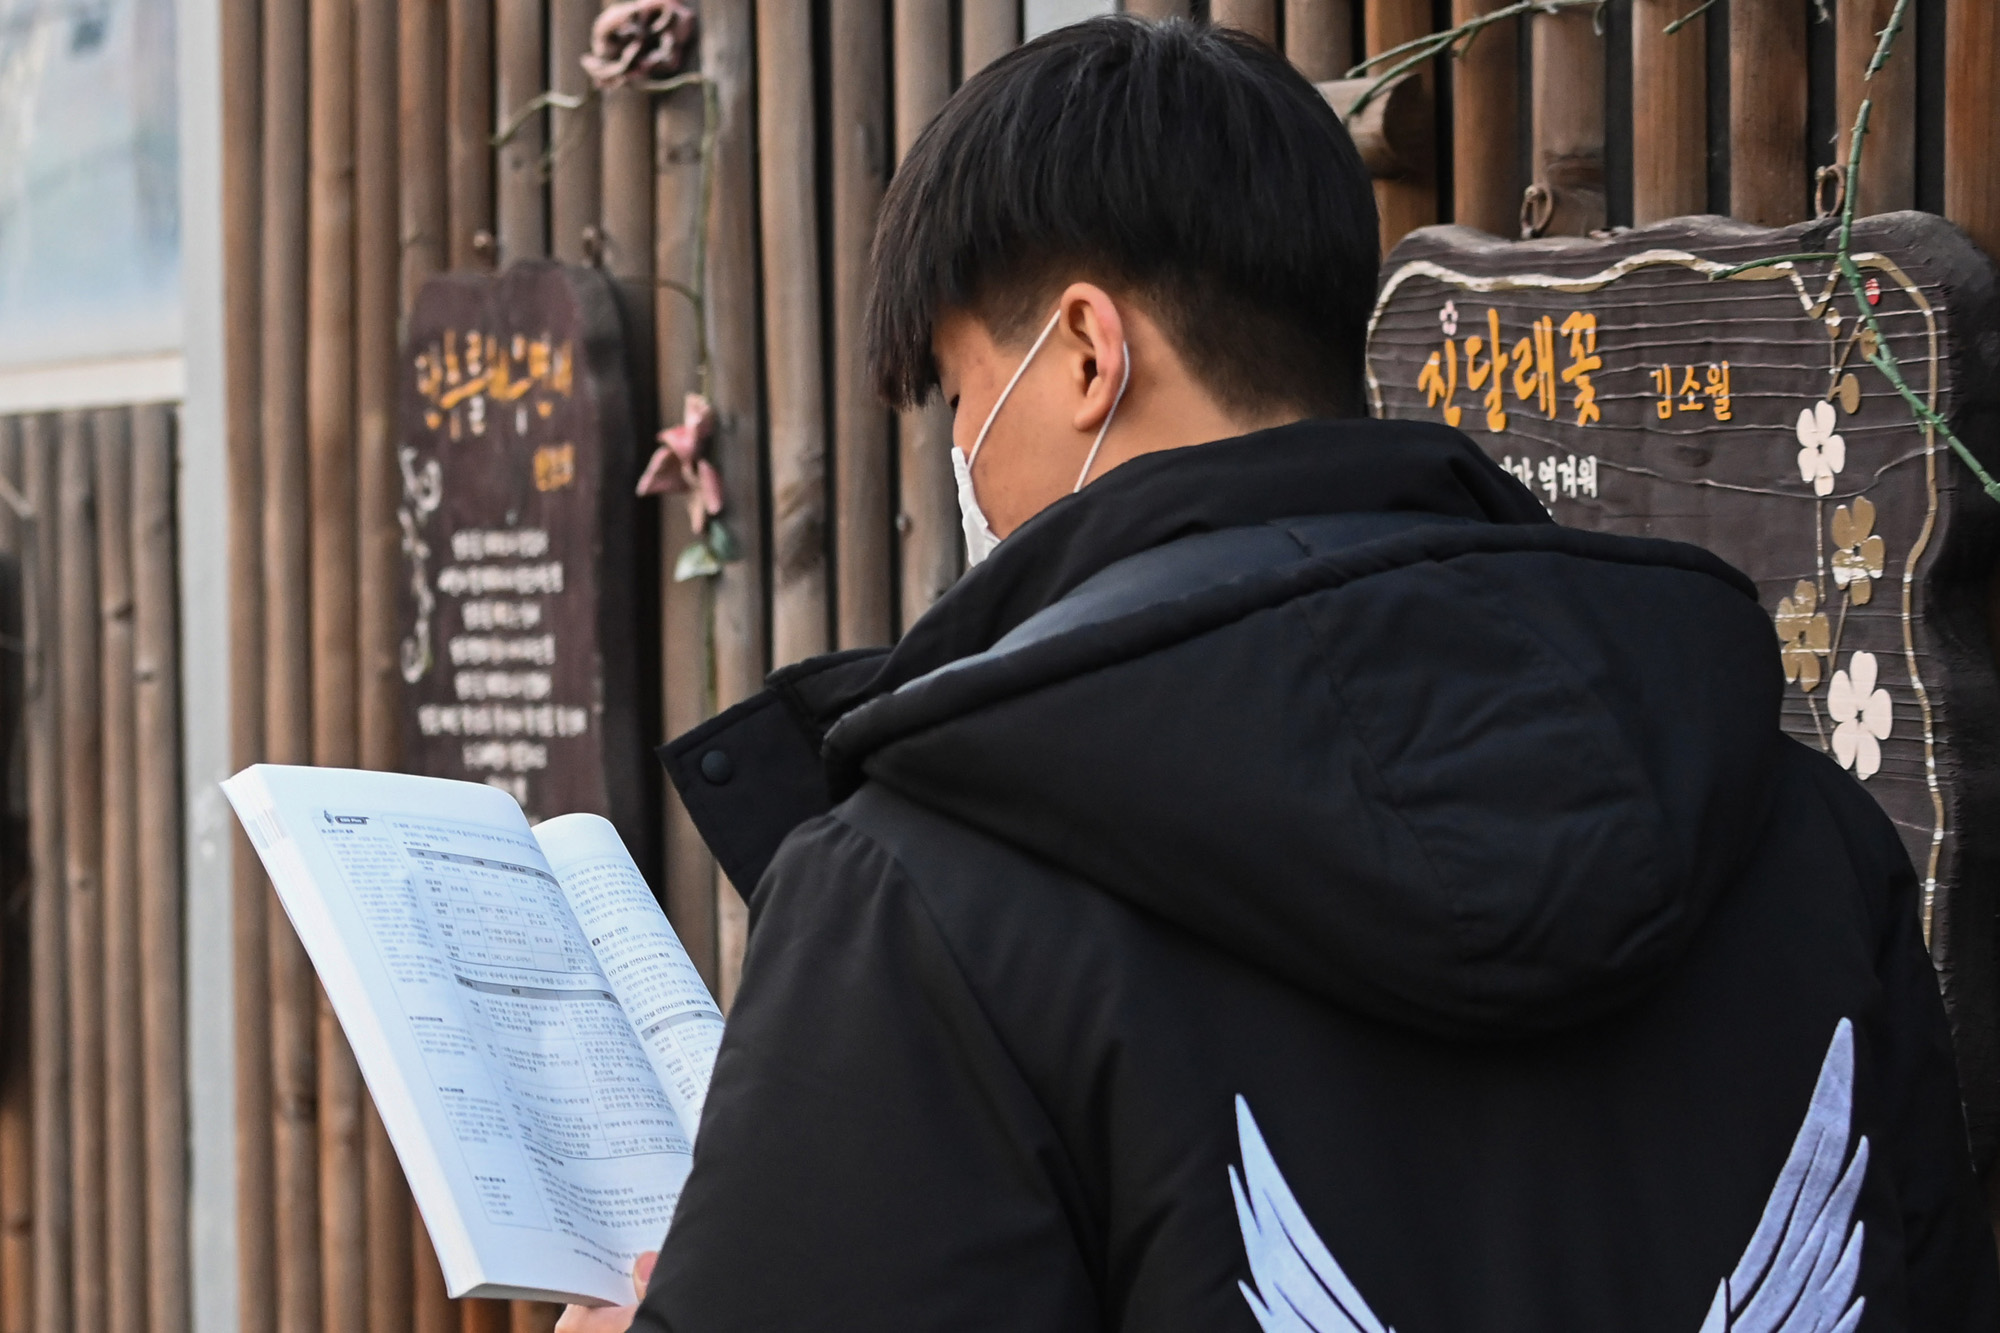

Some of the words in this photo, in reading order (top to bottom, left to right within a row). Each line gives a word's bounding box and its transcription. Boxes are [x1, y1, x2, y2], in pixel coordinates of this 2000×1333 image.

[1418, 308, 1601, 432] 진달래꽃
[1650, 360, 1731, 420] 김소월
[1539, 454, 1597, 502] 역겨워
